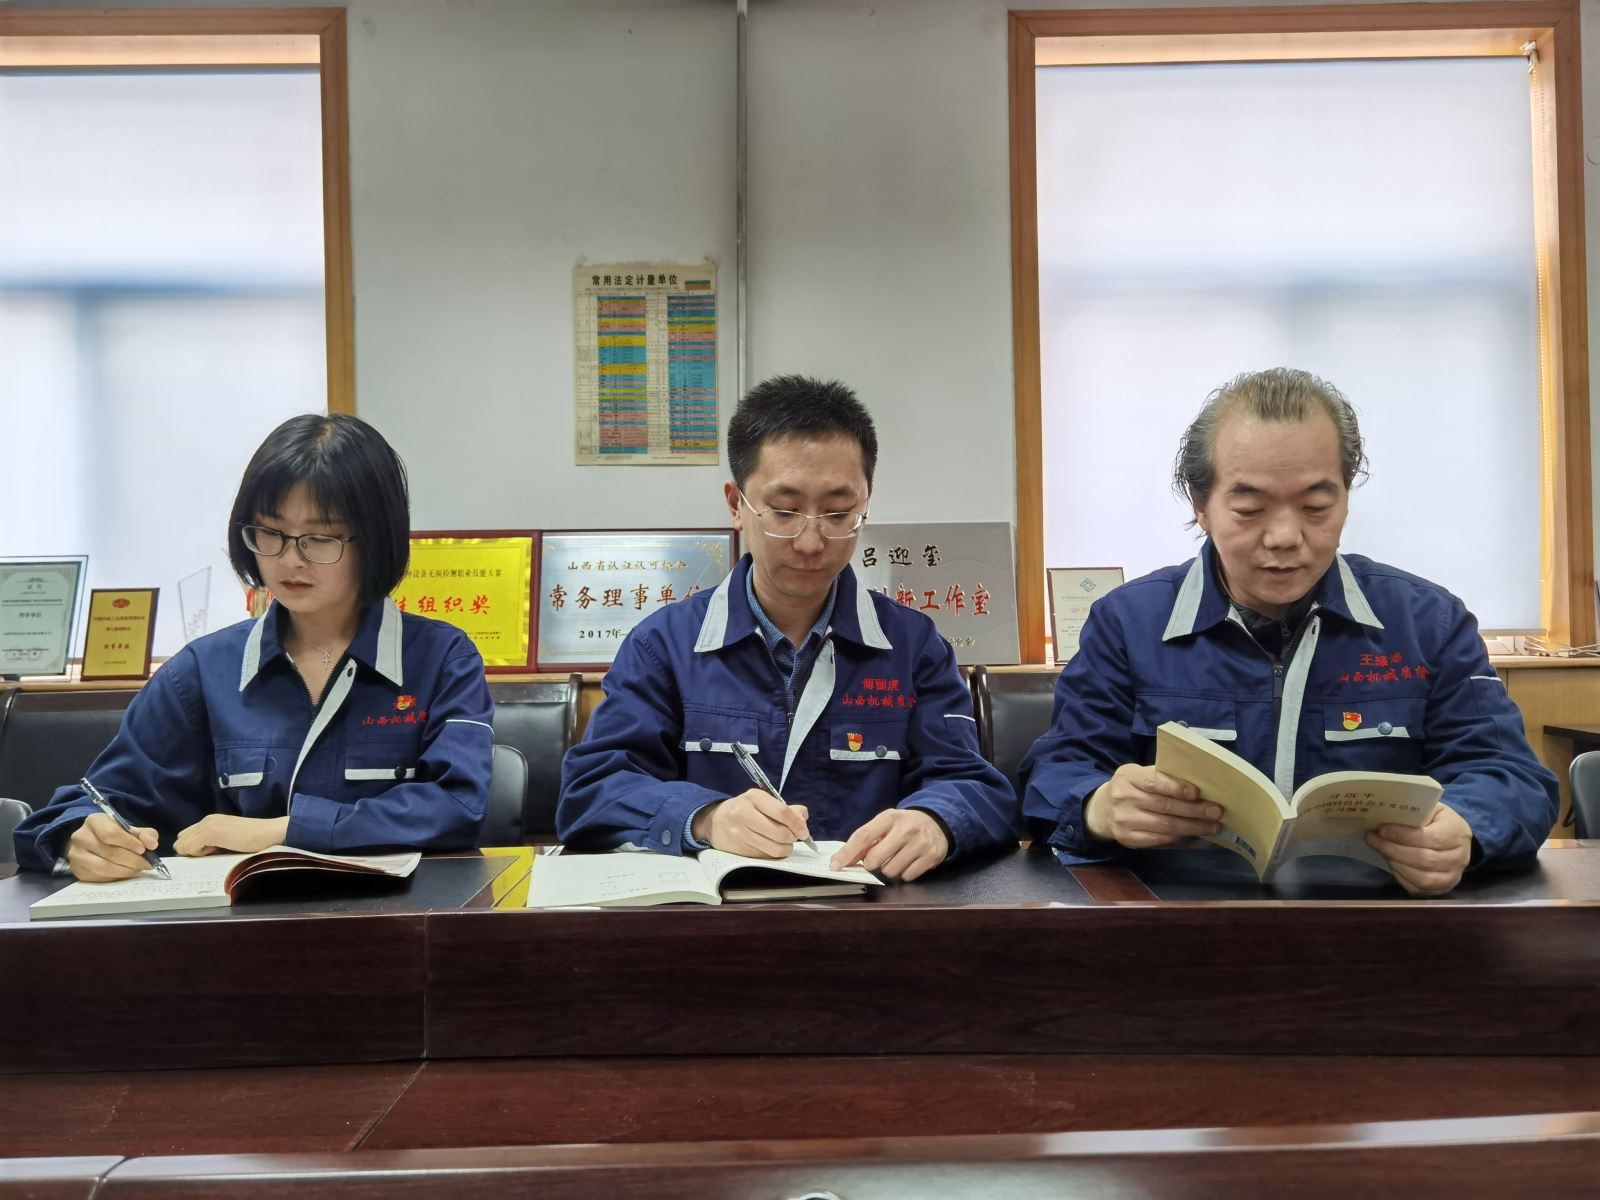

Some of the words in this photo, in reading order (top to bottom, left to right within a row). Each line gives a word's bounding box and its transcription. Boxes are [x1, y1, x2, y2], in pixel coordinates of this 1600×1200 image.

[592, 274, 678, 286] 常用法定计量单位
[862, 544, 942, 568] 吕迎玺
[567, 560, 688, 571] 山西省认证认可协会
[873, 583, 991, 617] 新工作室
